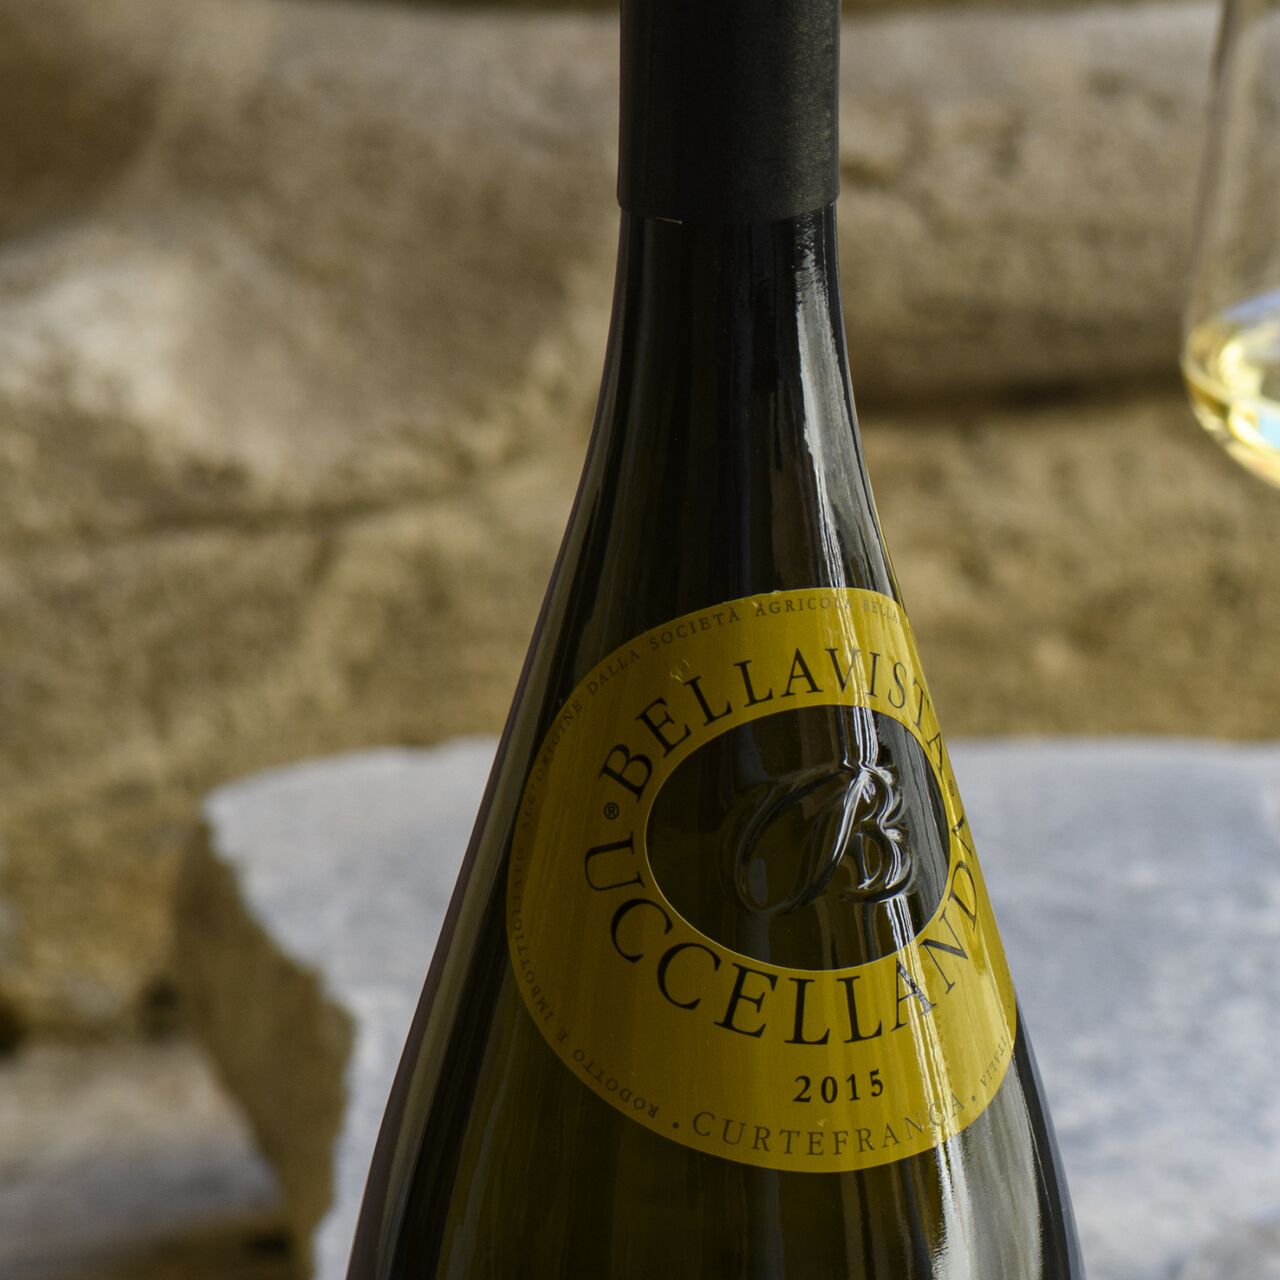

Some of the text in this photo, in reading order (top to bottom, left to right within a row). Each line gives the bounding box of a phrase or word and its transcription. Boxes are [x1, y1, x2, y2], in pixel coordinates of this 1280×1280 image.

[586, 649, 640, 696] DALLA
[650, 606, 740, 651] SOCIETÀ
[599, 646, 946, 803] BELLAVISTA
[792, 1068, 885, 1104] 2015
[692, 1093, 965, 1156] CURTEFRANCA
